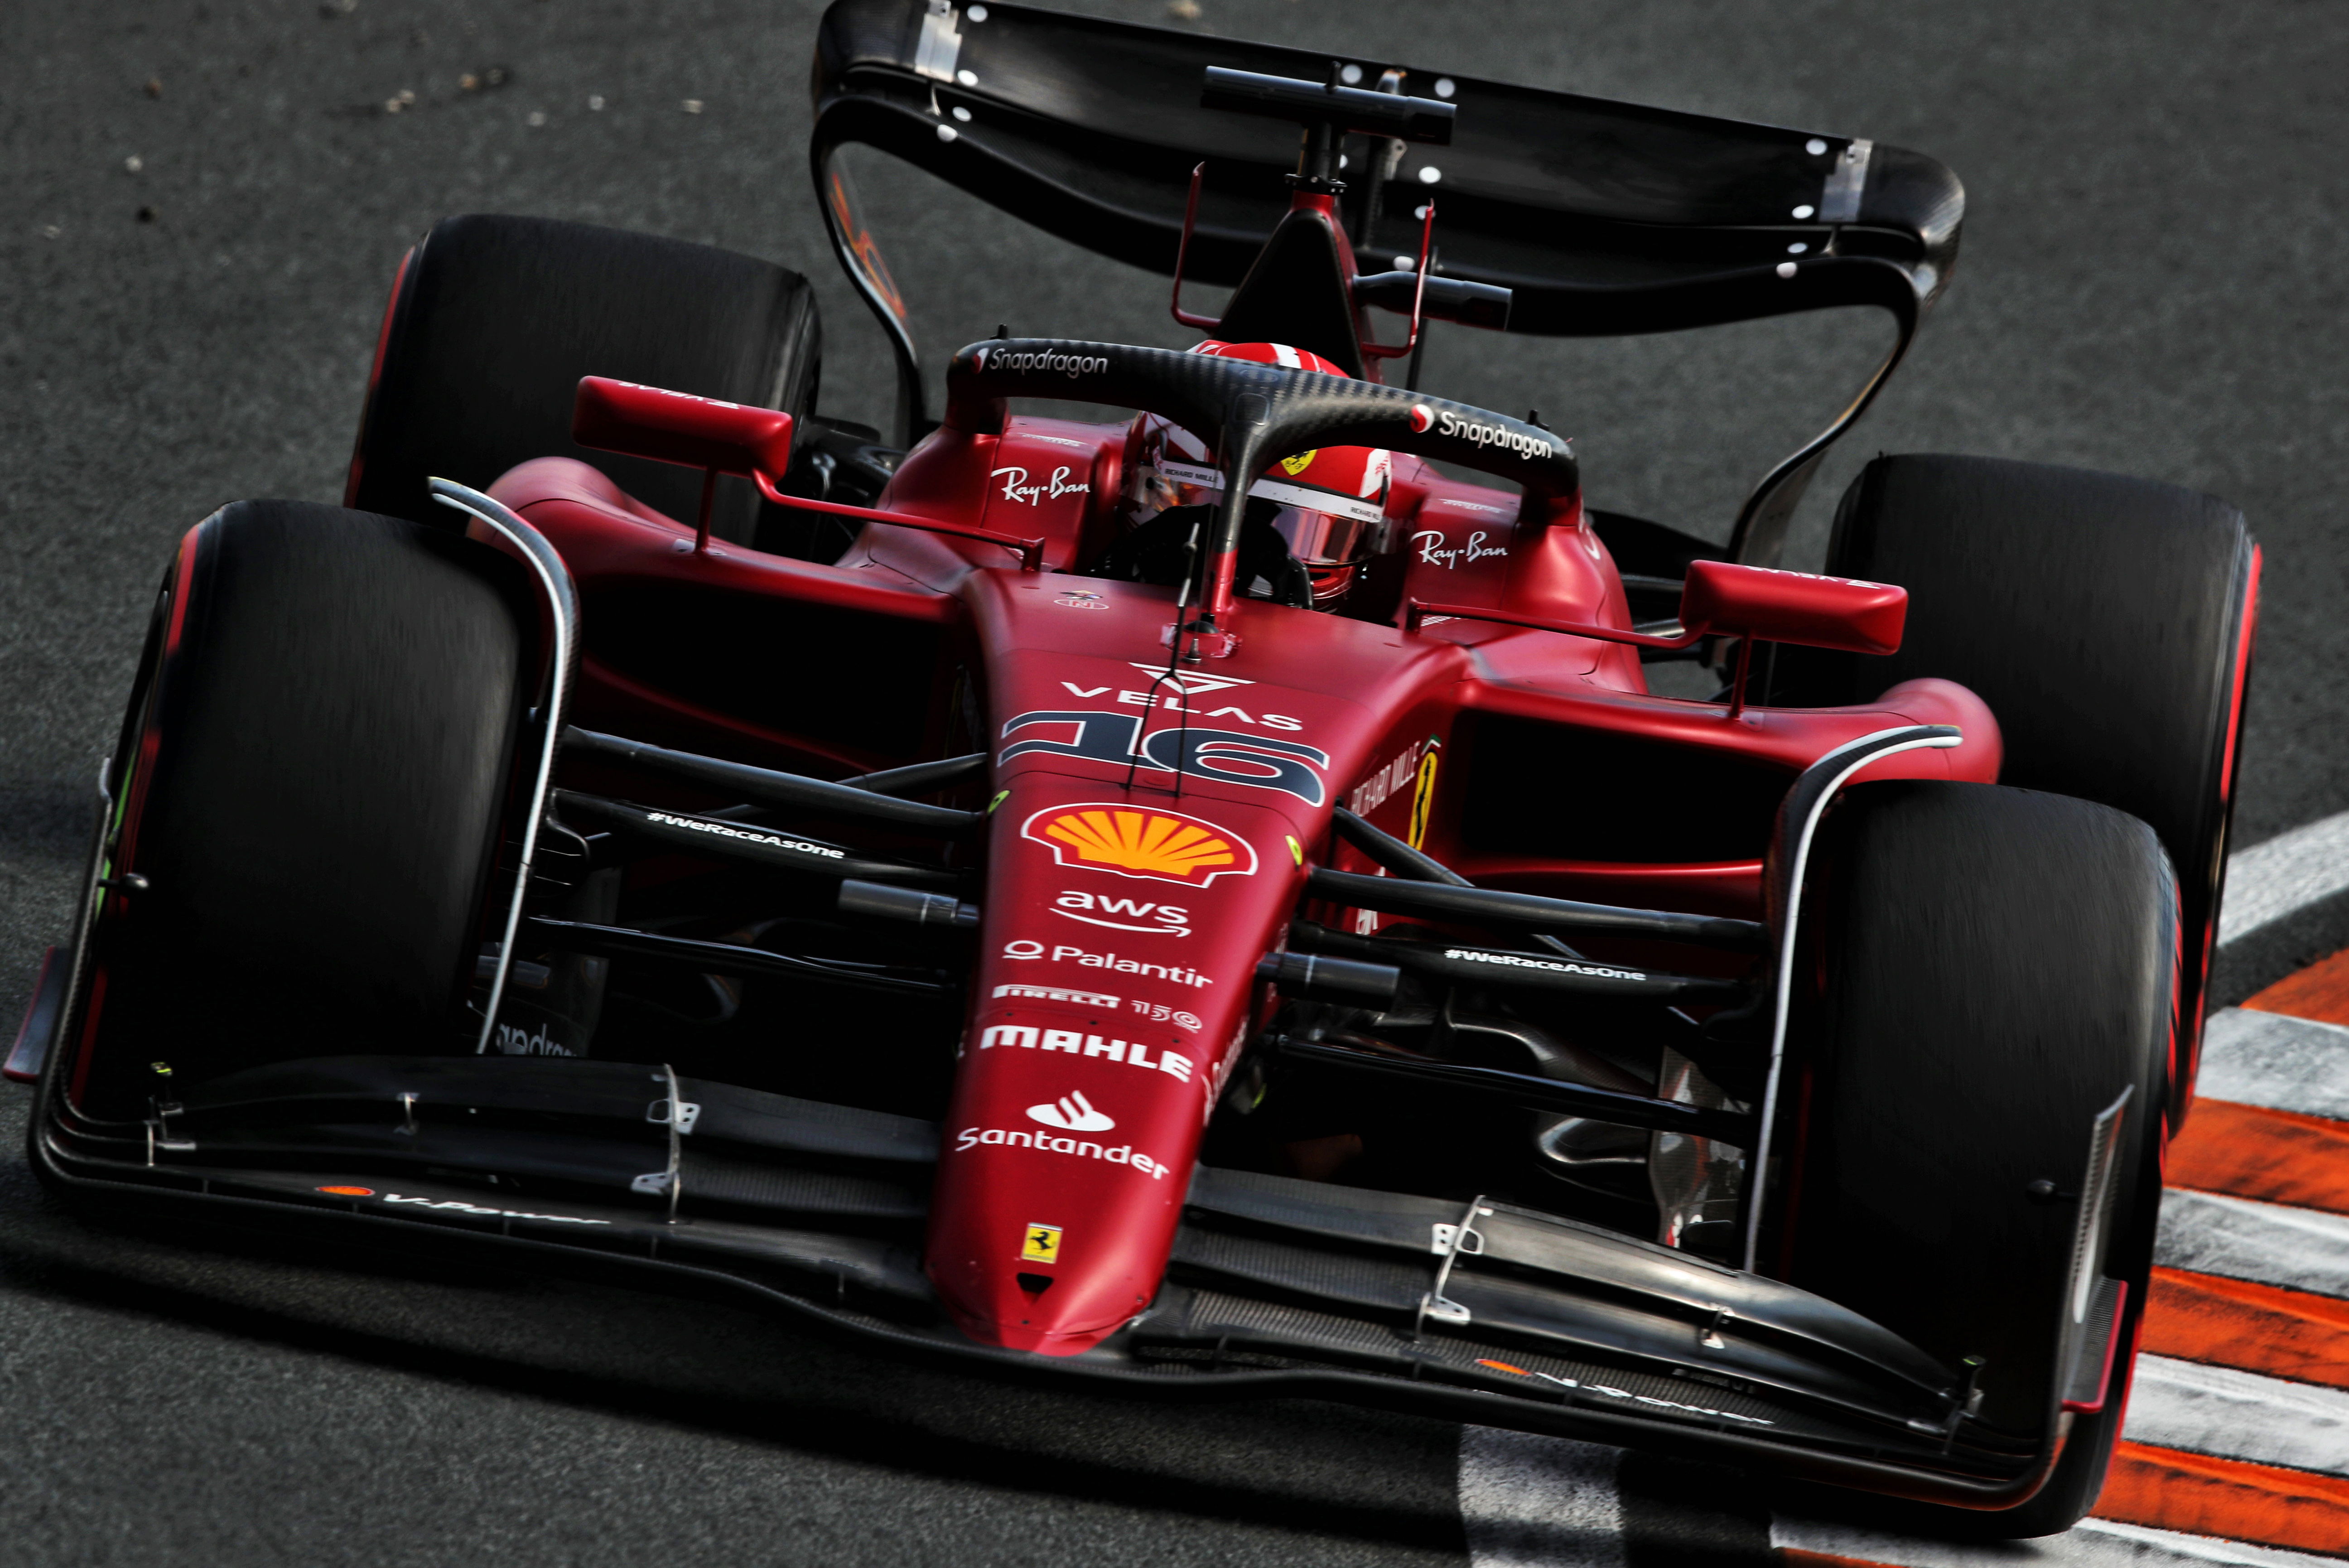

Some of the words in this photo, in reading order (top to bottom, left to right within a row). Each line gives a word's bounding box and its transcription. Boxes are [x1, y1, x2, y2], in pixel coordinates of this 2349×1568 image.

[989, 348, 1108, 379] Snapdragon
[1438, 411, 1553, 460] Snapdragon
[1061, 681, 1303, 732] VELAS
[997, 710, 1331, 808] 16
[647, 812, 845, 860] #WeRaceAsOne
[1056, 890, 1190, 926] aws
[1052, 945, 1213, 989] Palantir
[1445, 949, 1647, 981] #WeRaceAsOne
[992, 984, 1121, 1009] PIRELLI
[980, 1024, 1194, 1083] MAHLE
[955, 1127, 1170, 1181] Santander
